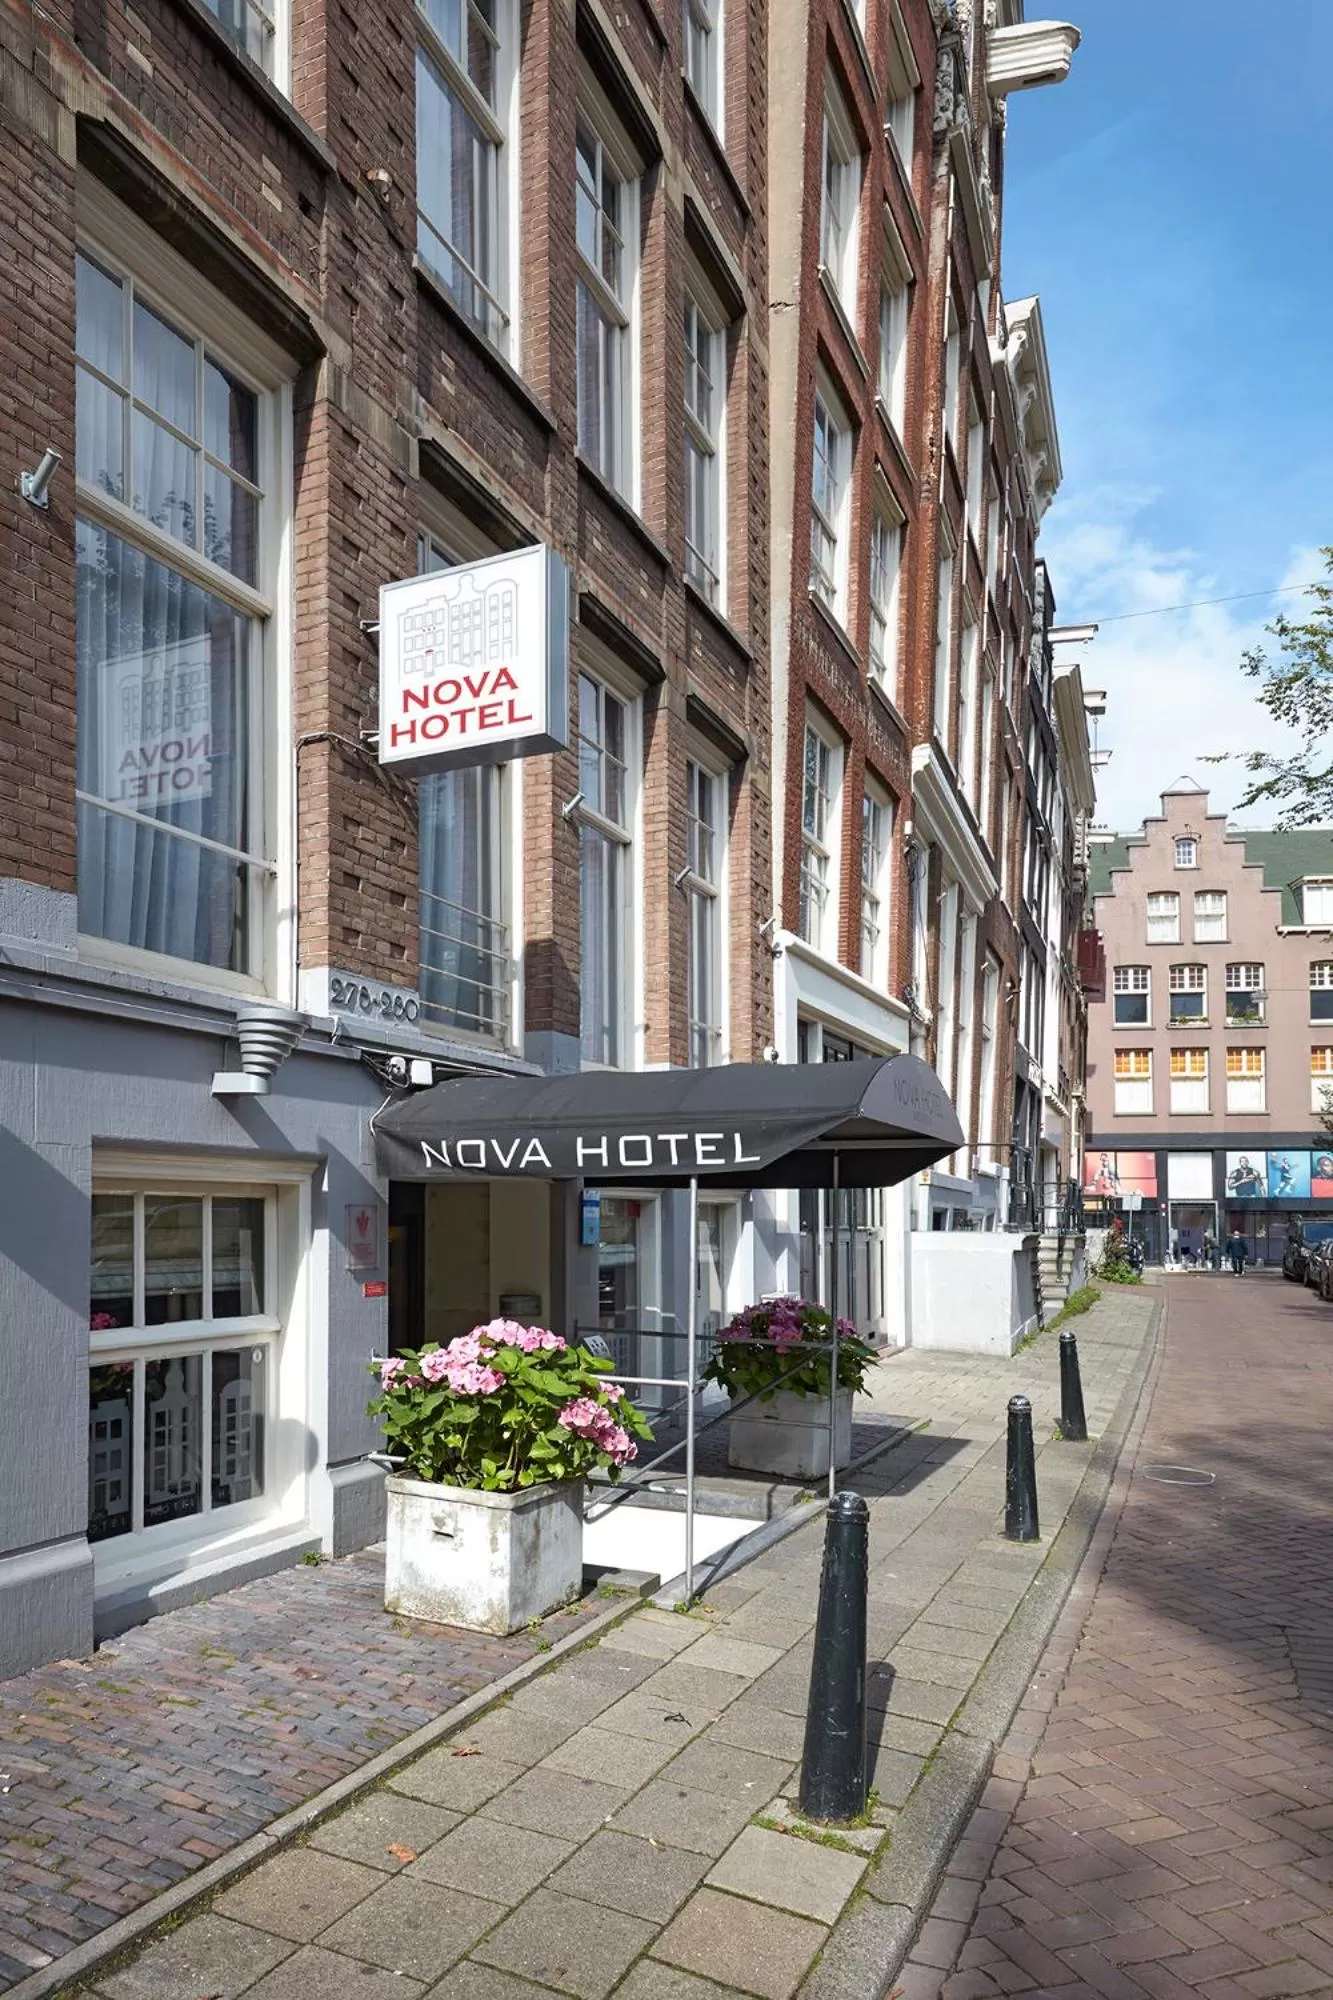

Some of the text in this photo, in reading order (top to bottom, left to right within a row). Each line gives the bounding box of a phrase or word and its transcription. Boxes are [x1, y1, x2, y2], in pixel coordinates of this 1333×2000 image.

[402, 667, 519, 714] NOVA
[390, 698, 533, 748] HOTEL
[894, 1078, 920, 1109] NOVA
[420, 1132, 762, 1169] NOVA HOTEL
